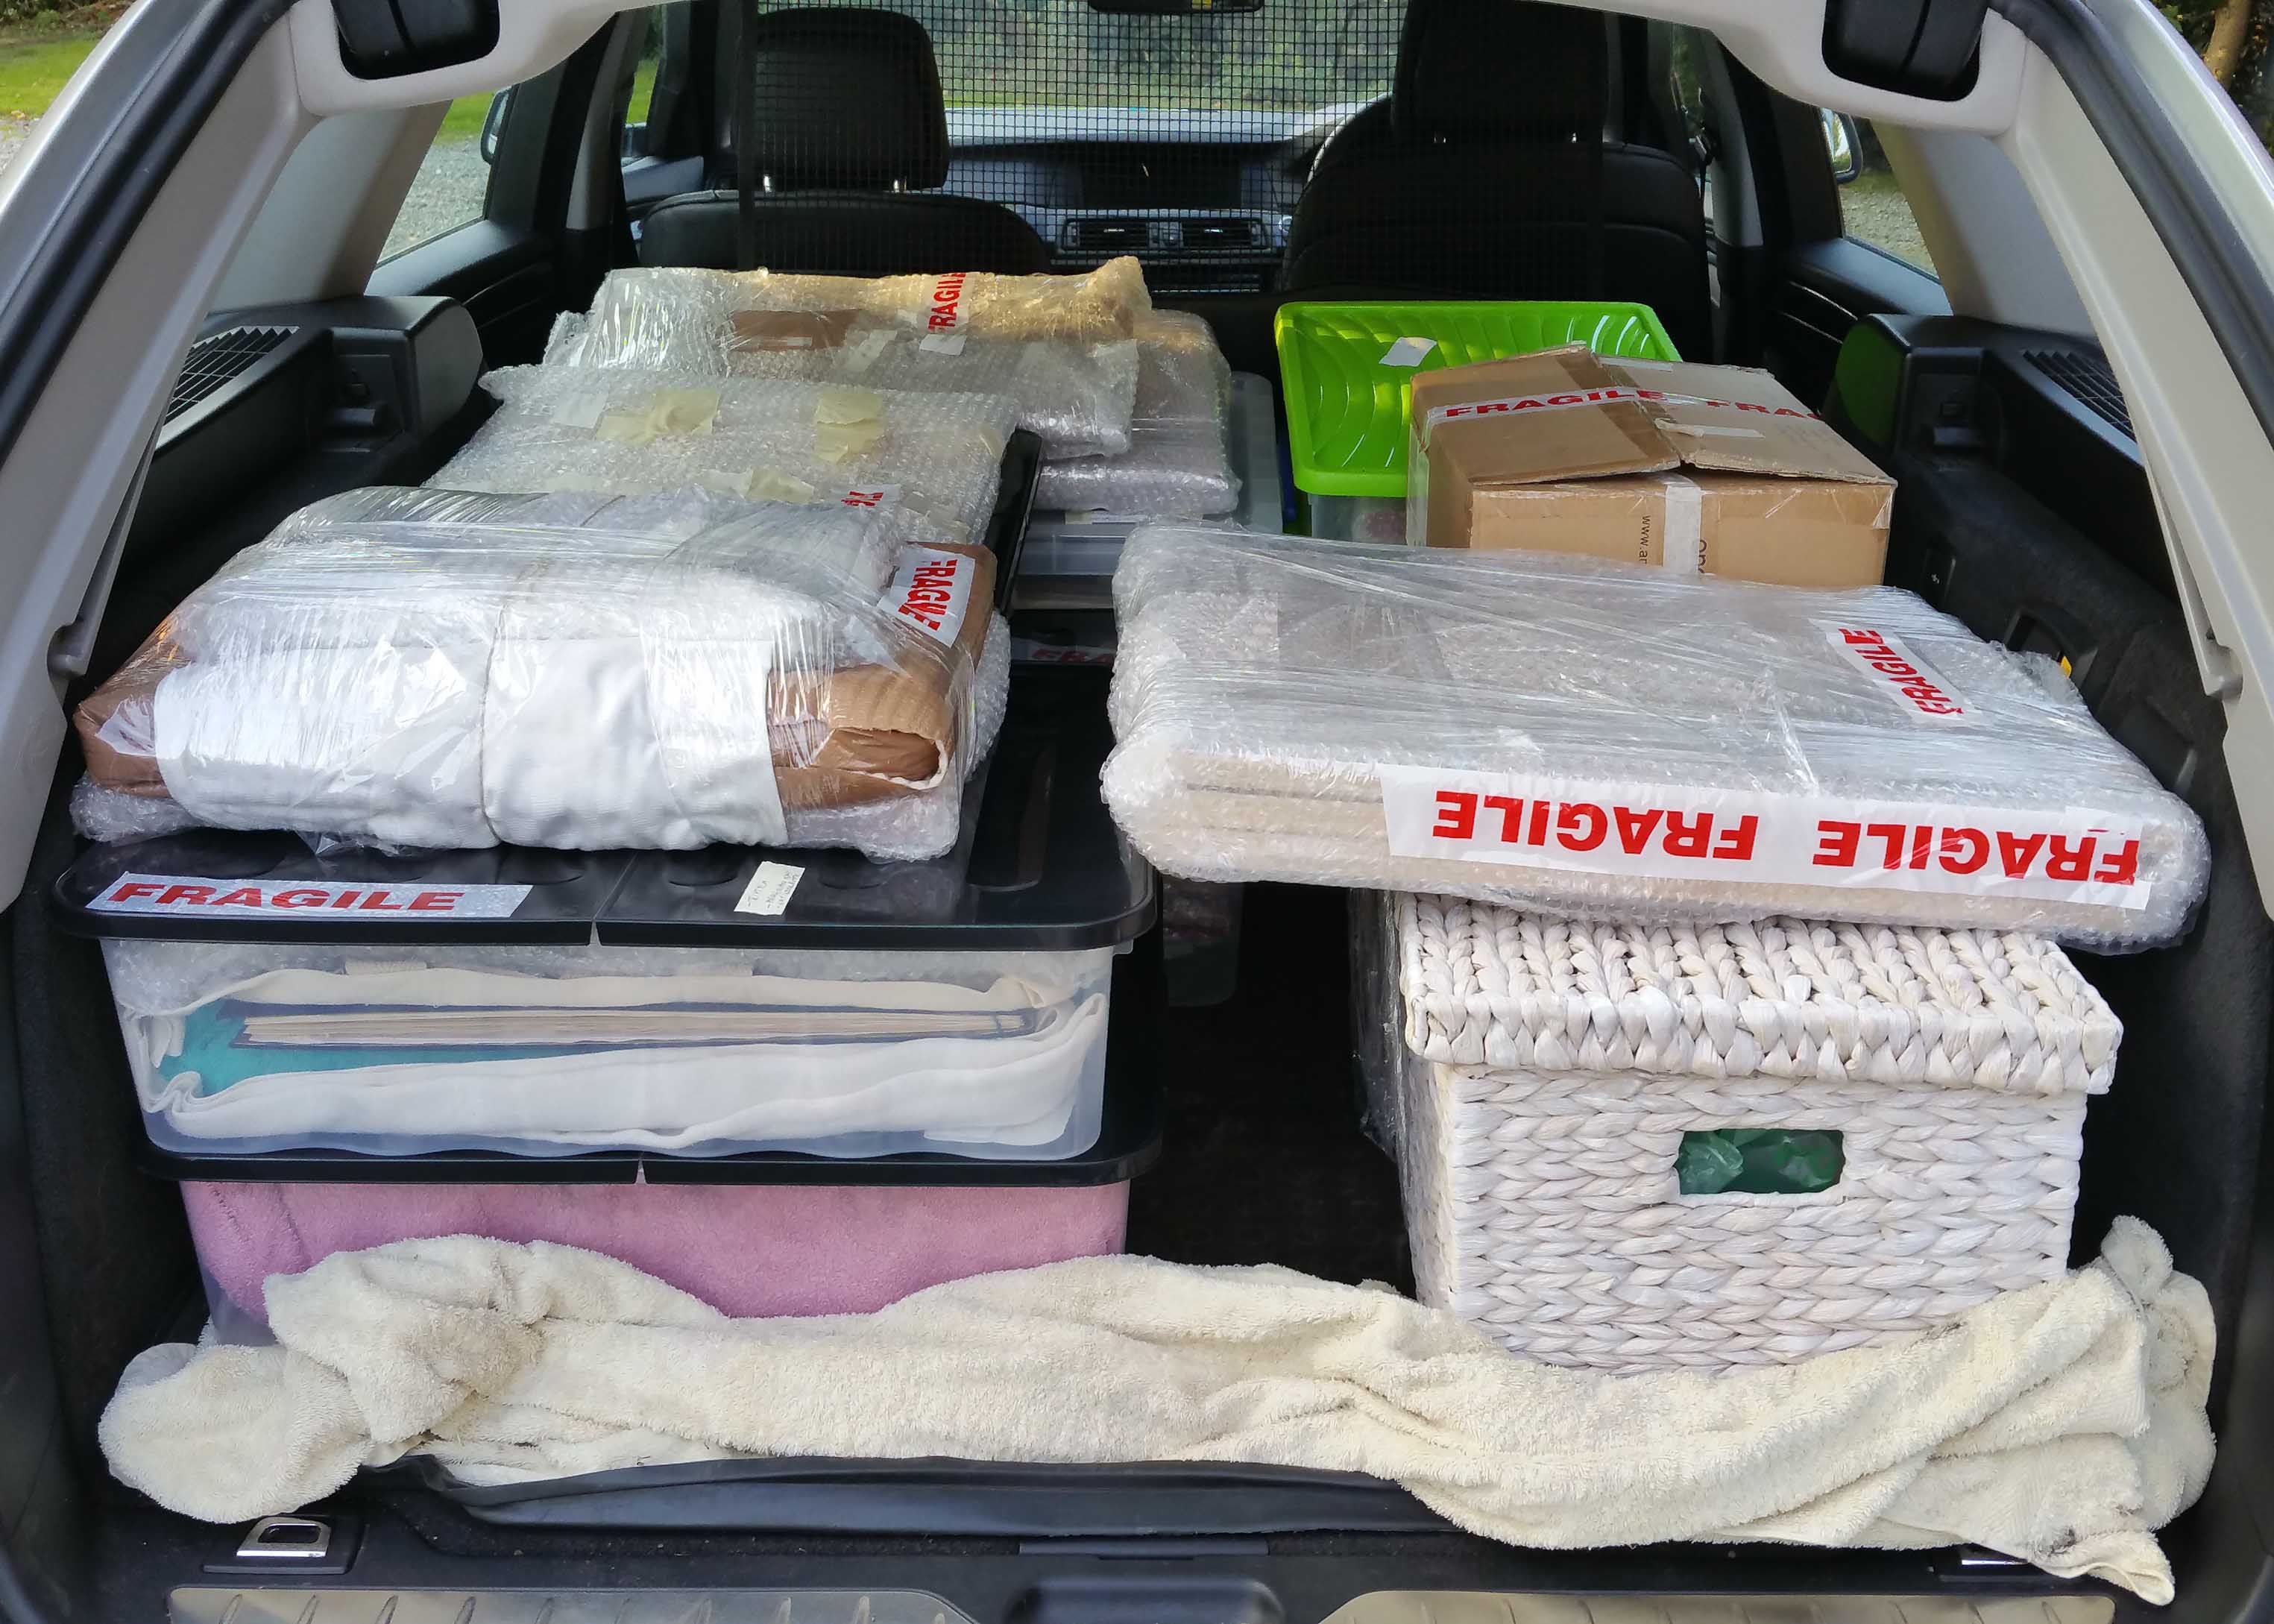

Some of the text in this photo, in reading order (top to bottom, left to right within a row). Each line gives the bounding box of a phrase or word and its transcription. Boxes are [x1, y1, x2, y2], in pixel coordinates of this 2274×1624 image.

[1445, 390, 1666, 417] FRAGILE
[1838, 628, 1964, 714] FRAGILE
[1432, 790, 2142, 885] FRAGILE FRAGILE
[108, 882, 464, 912] FRAGILE
